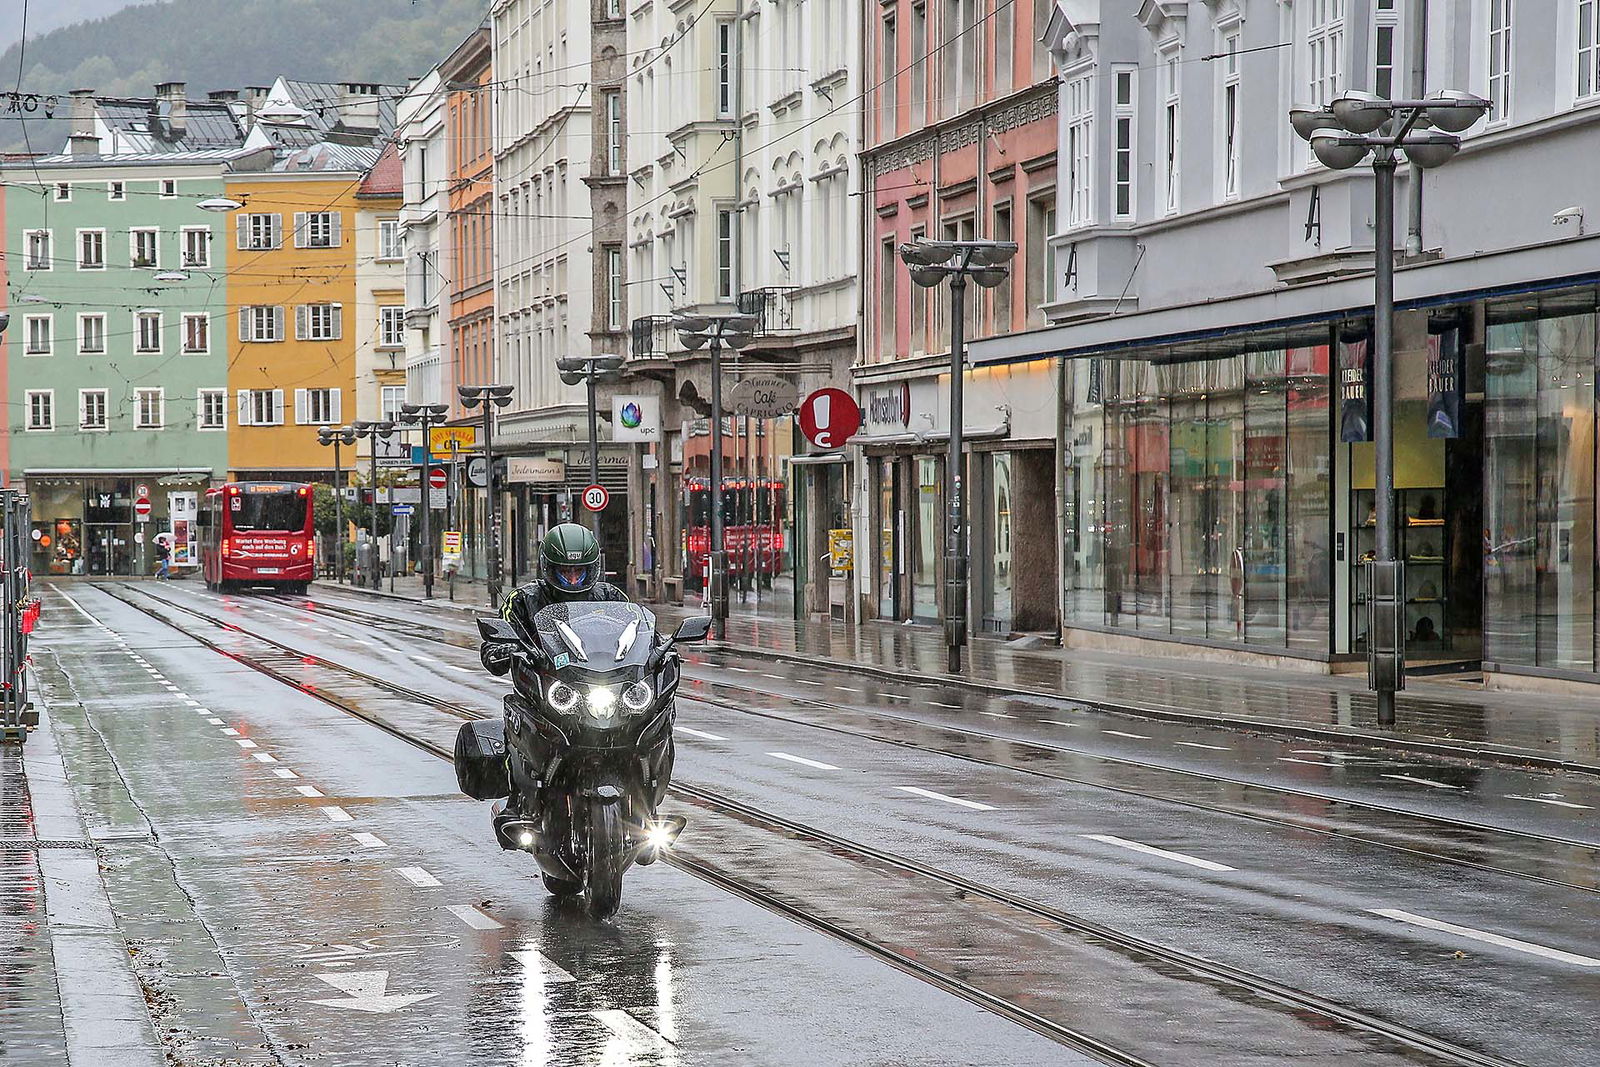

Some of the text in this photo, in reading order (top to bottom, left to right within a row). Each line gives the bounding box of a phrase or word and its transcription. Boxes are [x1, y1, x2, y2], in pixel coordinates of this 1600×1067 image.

[1429, 377, 1455, 393] BAUER
[754, 390, 778, 408] Café
[737, 402, 793, 417] CAPRICCIO
[640, 427, 655, 436] upc
[577, 450, 628, 465] Jeerma
[589, 492, 602, 504] 30
